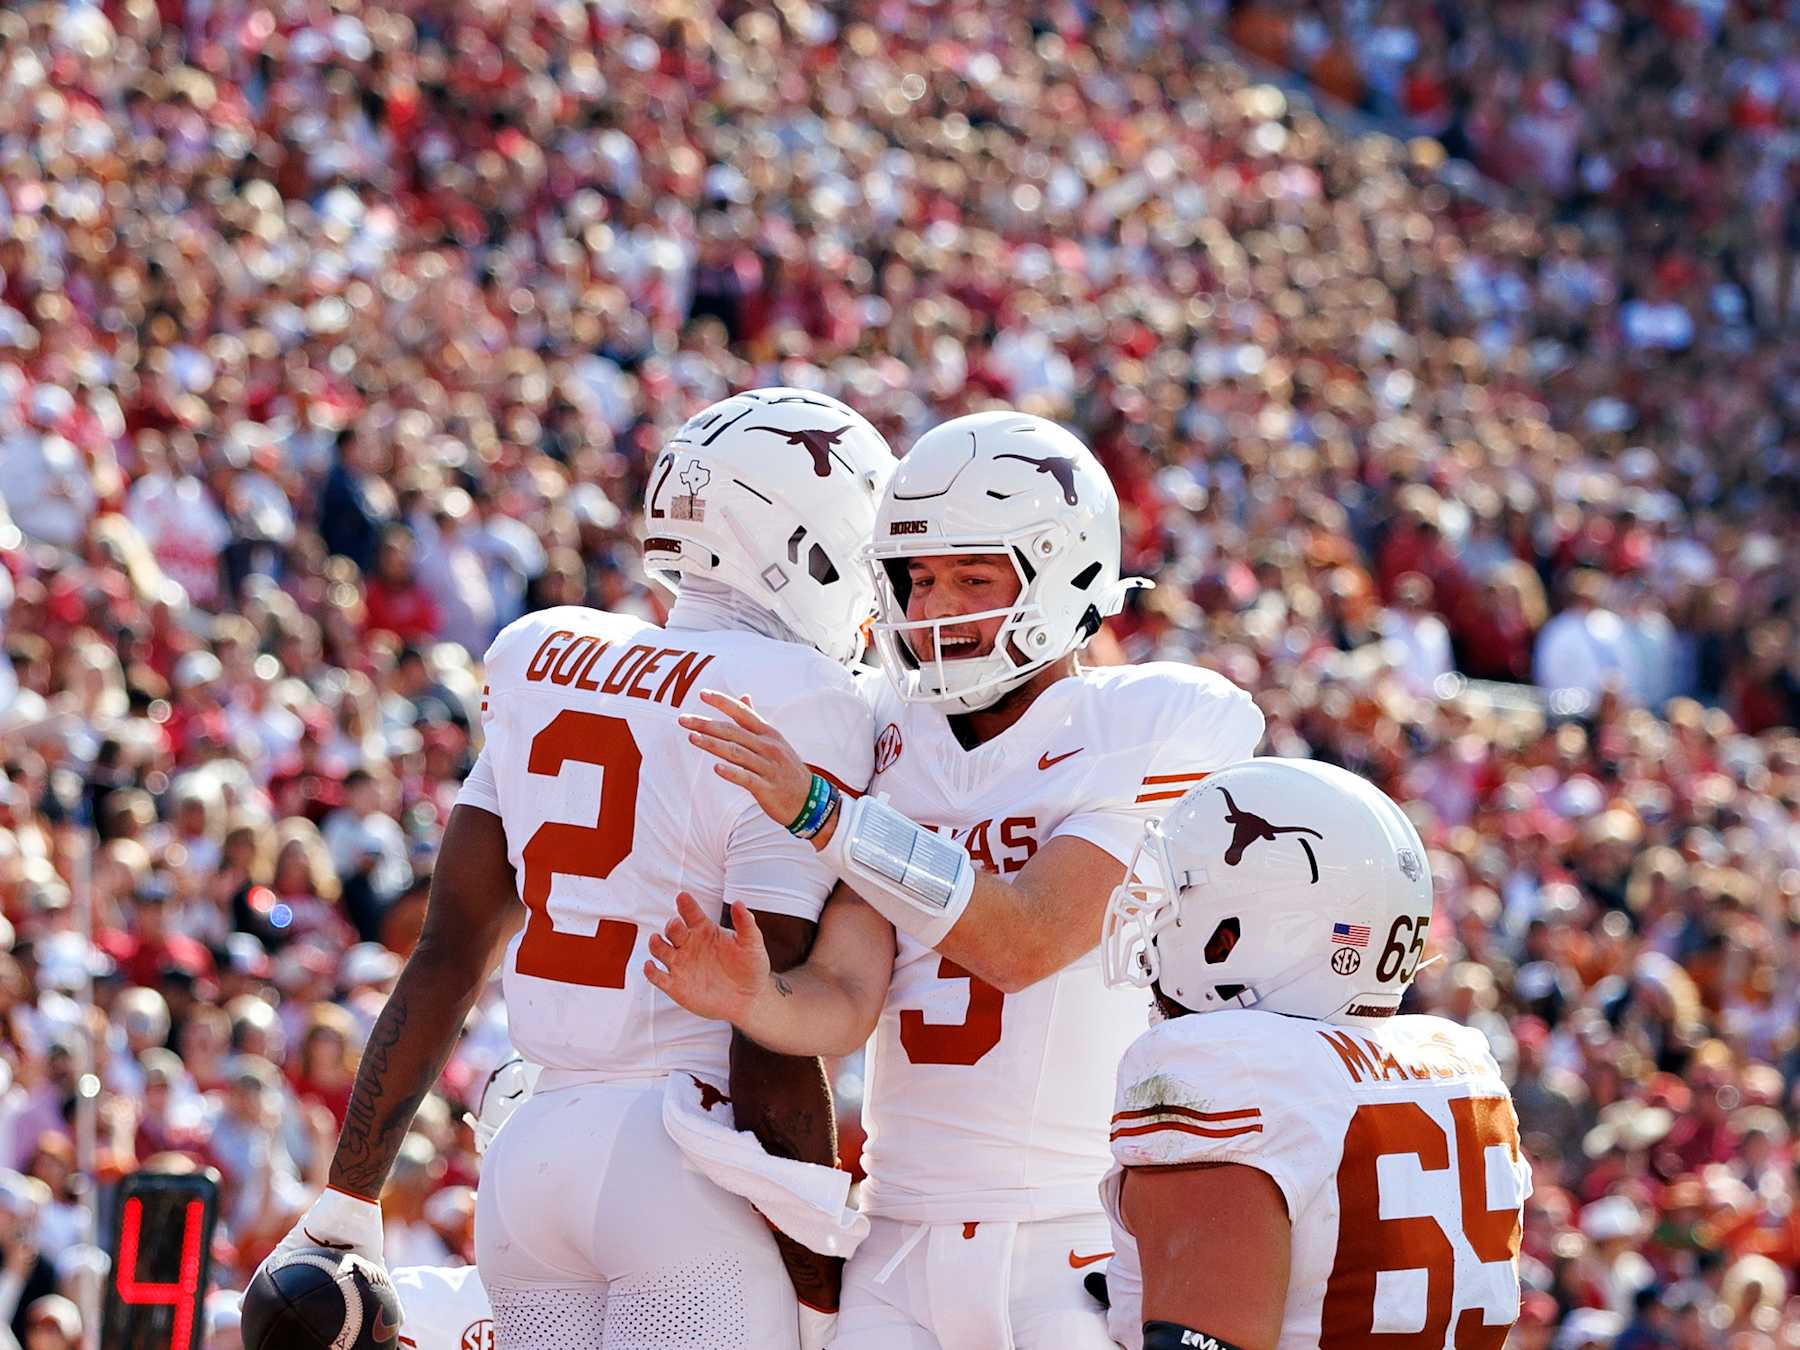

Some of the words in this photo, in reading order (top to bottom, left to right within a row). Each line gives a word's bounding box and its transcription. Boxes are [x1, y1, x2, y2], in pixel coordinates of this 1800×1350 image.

[651, 453, 676, 519] 2
[890, 520, 928, 536] HORNS
[526, 630, 716, 709] GOLDEN
[515, 708, 643, 990] 2
[1331, 948, 1360, 975] SEC
[1376, 915, 1430, 984] 65
